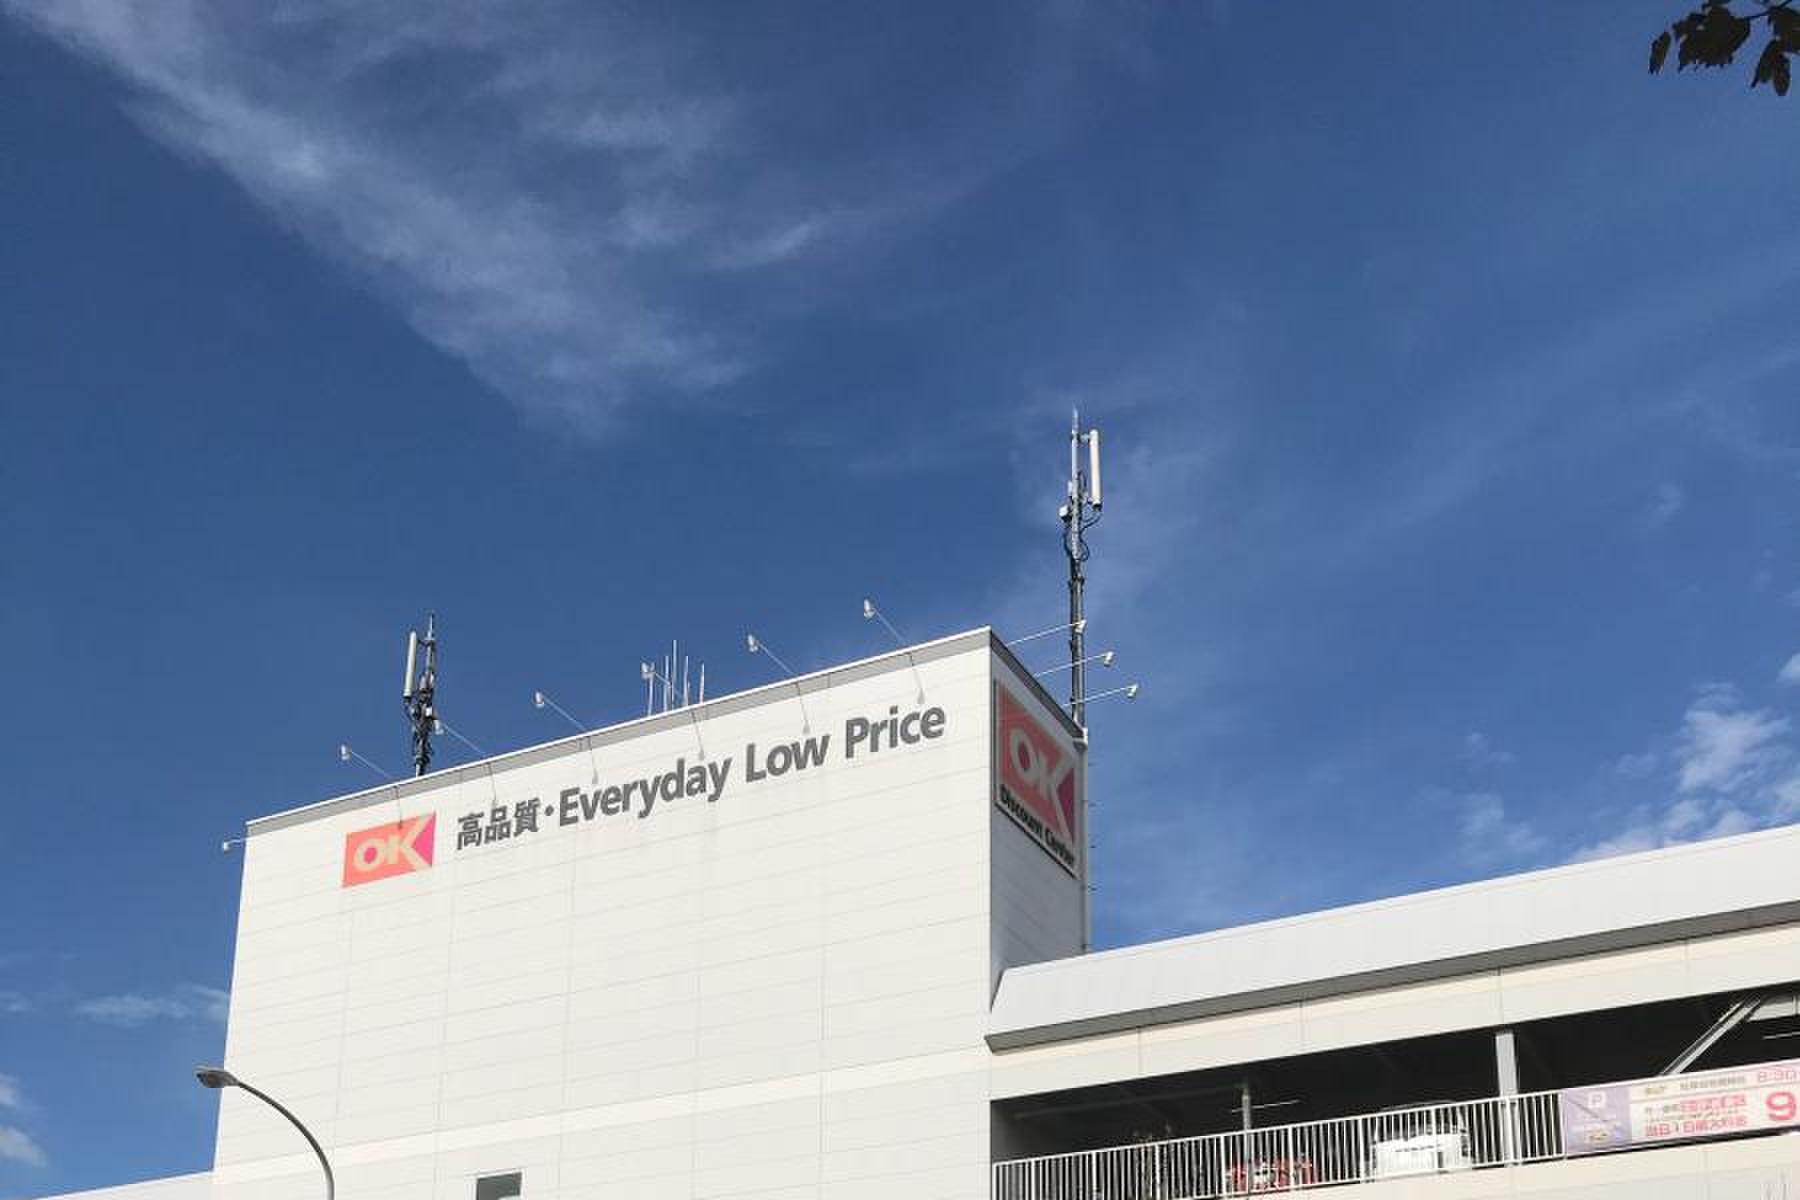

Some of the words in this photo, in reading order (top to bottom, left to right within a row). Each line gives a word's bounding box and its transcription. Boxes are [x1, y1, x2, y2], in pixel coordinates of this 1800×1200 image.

[745, 733, 831, 784] Low
[845, 705, 946, 760] Price
[1009, 727, 1074, 843] OK
[353, 813, 434, 872] OK
[1765, 1090, 1797, 1121] 9
